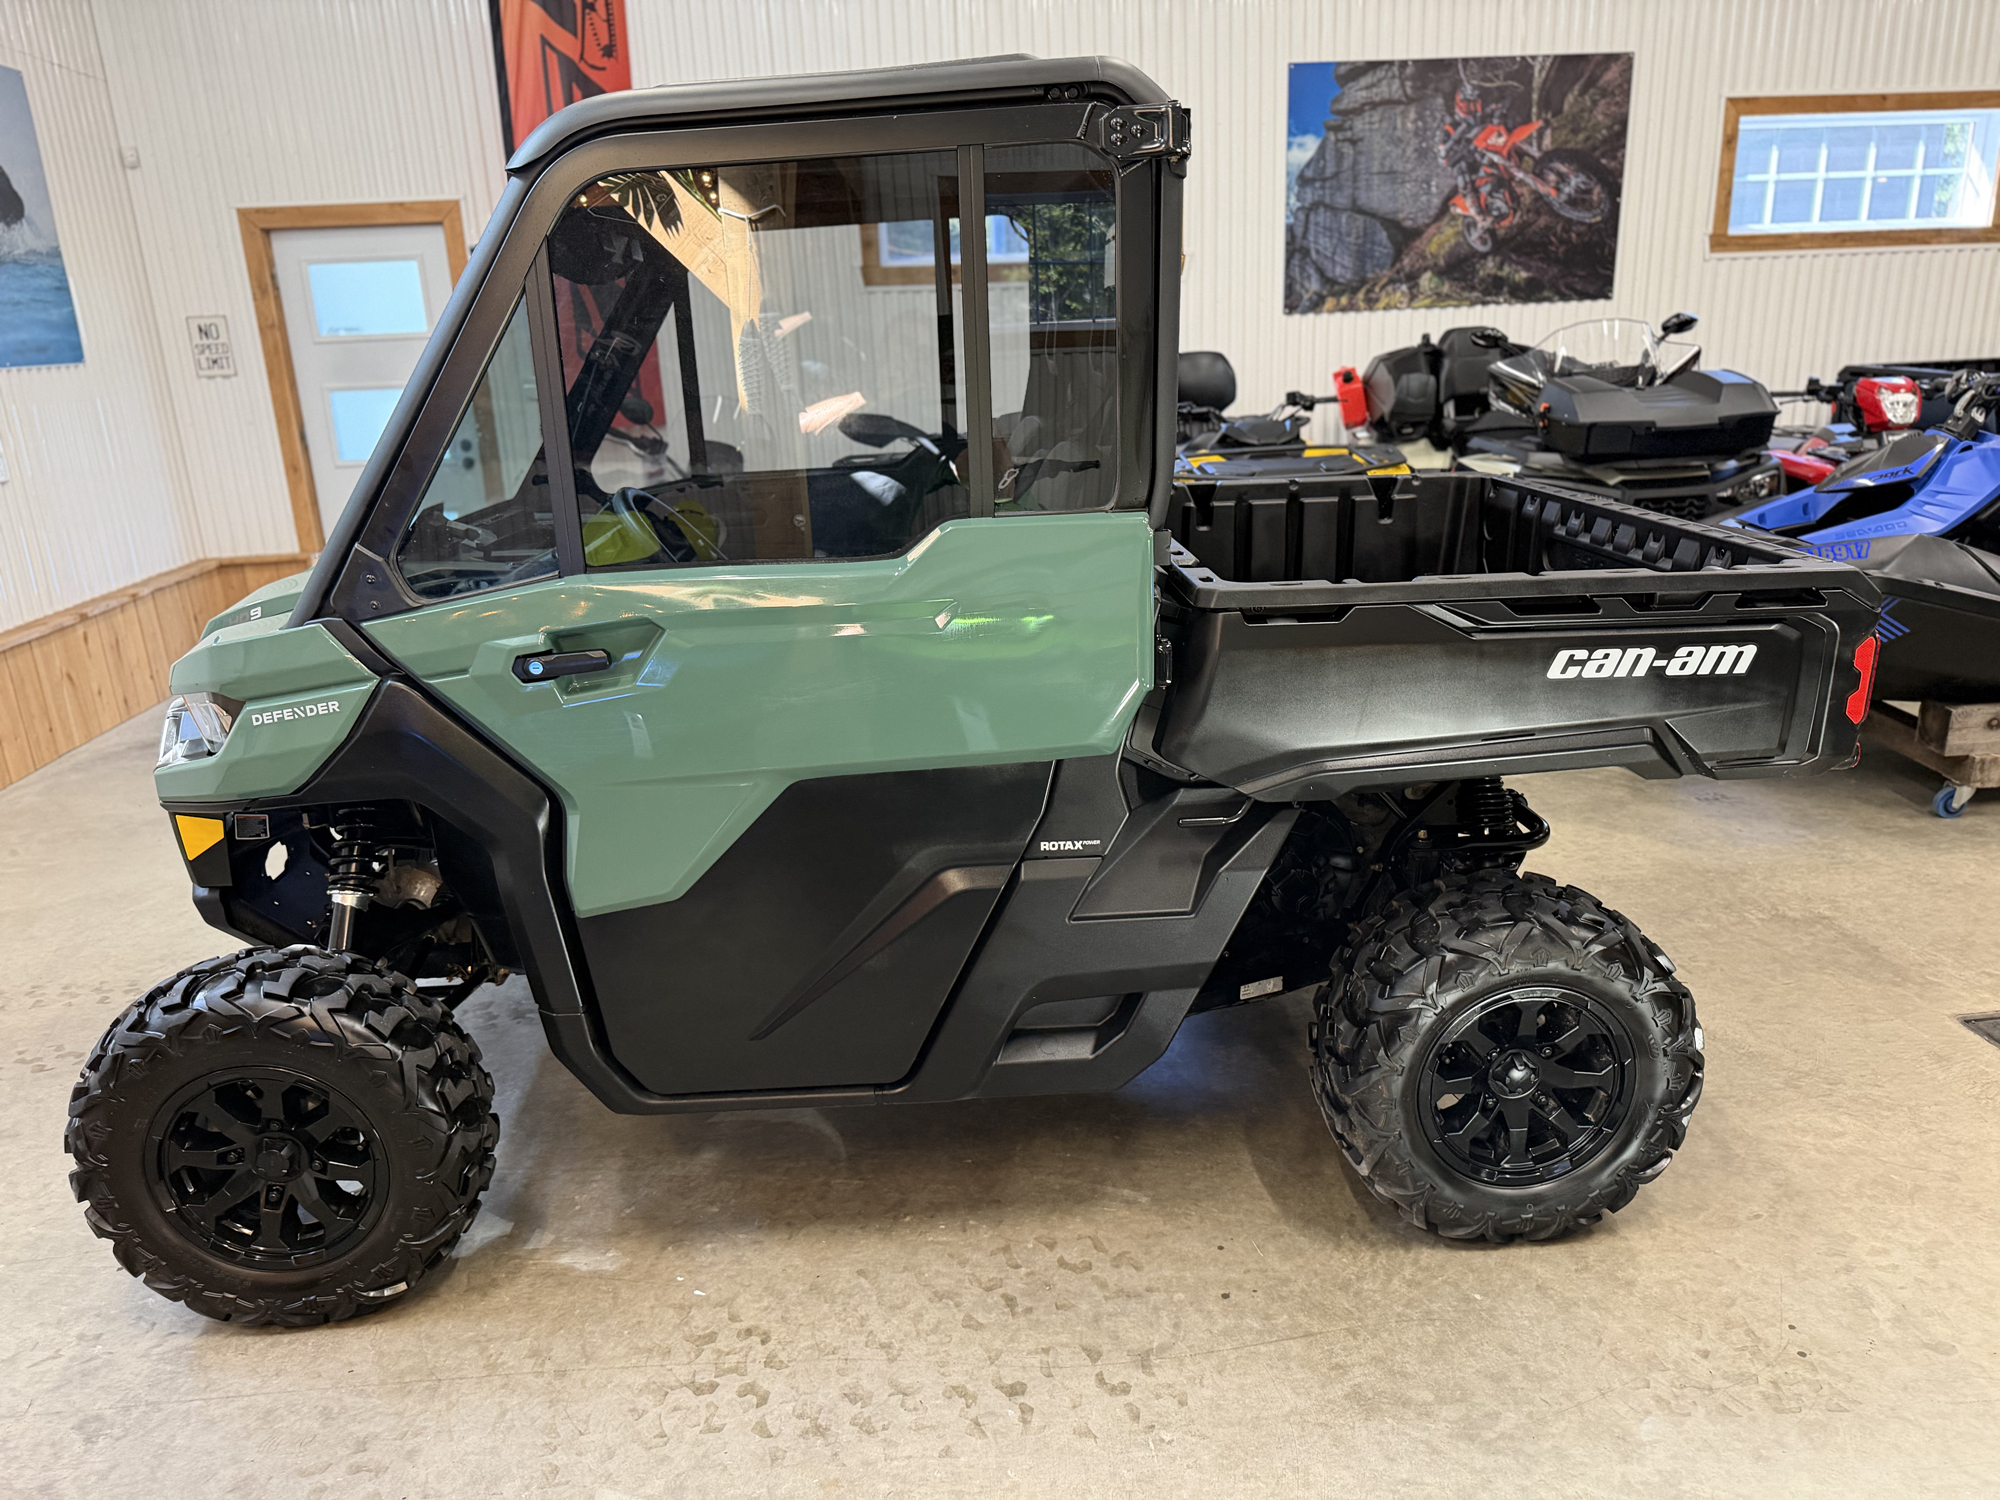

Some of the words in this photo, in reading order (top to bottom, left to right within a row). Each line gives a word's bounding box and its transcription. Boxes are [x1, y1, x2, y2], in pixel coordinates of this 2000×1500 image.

[197, 323, 220, 341] NO
[197, 356, 231, 370] LIMIT
[1546, 644, 1758, 679] can-am
[251, 700, 340, 726] DEFENDER
[1040, 841, 1084, 851] ROTAX
